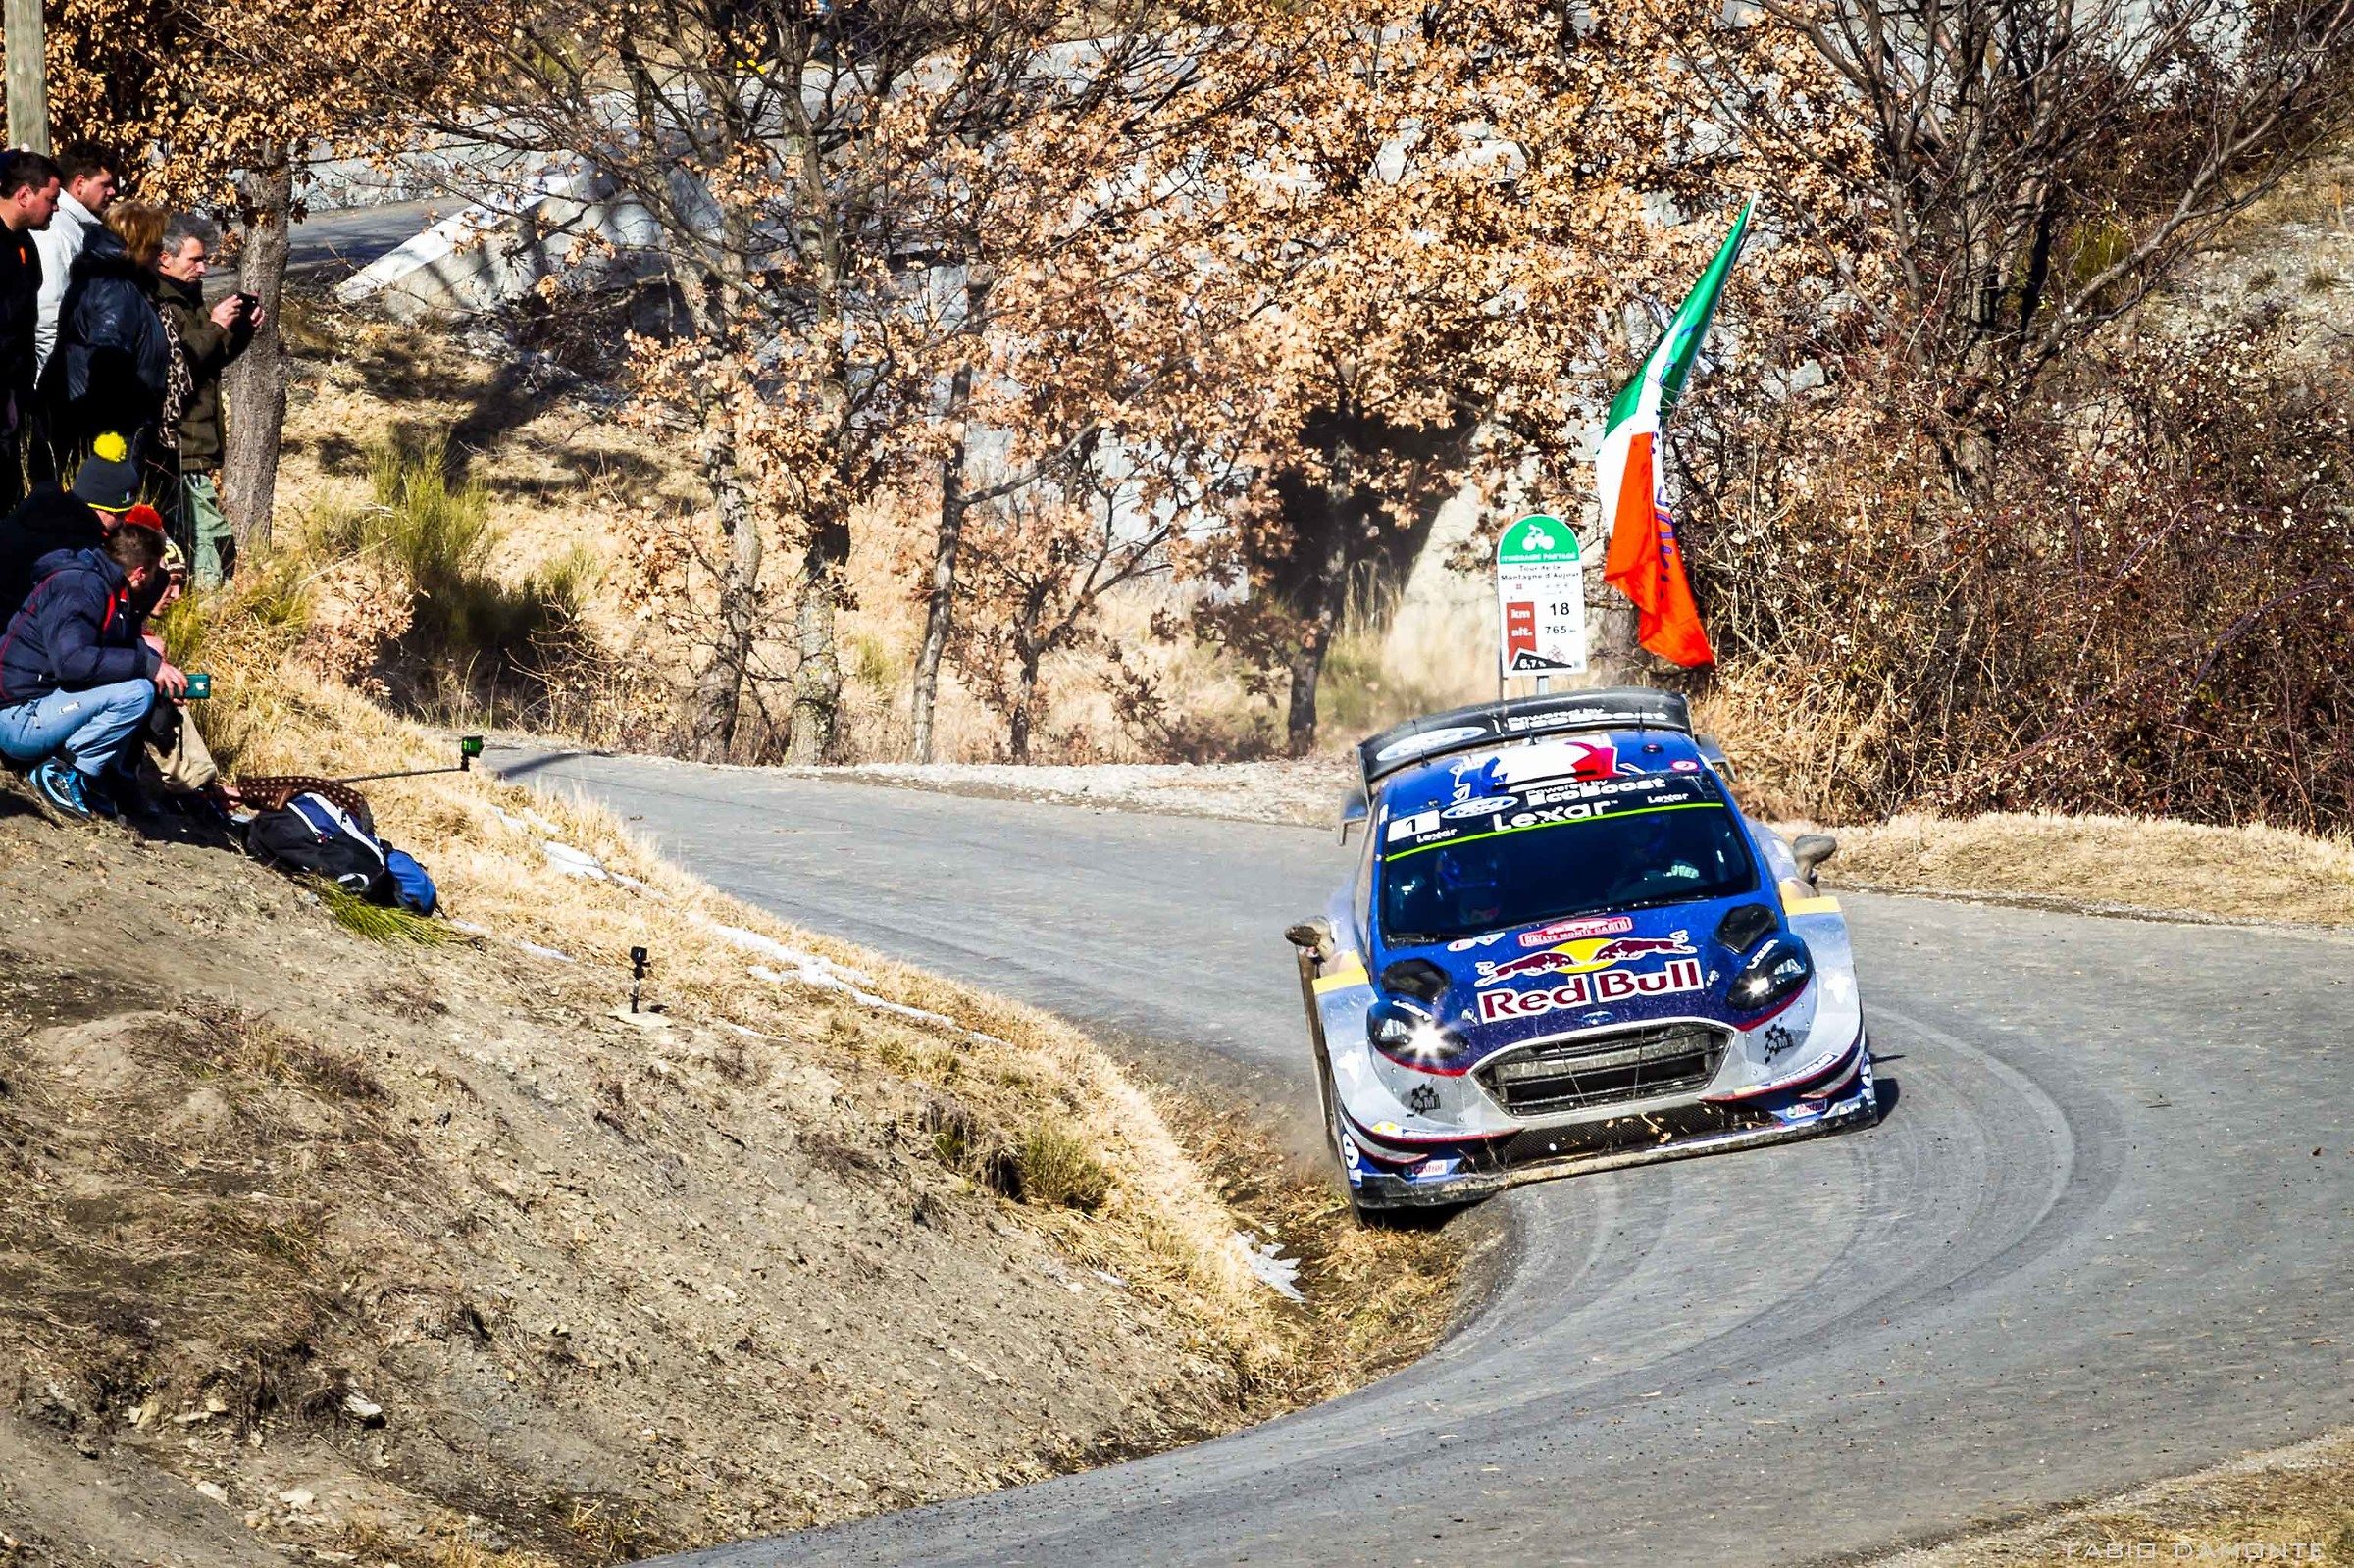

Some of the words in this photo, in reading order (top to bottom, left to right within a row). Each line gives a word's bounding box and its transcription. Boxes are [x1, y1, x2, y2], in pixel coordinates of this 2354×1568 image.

[1510, 609, 1530, 619] km
[1550, 602, 1569, 616] 18
[1545, 625, 1567, 634] 765
[1526, 777, 1666, 806] EcoBoost
[1406, 818, 1416, 833] 1
[1416, 828, 1458, 844] Lexar
[1492, 800, 1611, 833] Lexar
[1647, 792, 1689, 805] Lexar
[1482, 977, 1587, 1019] Red
[1597, 961, 1699, 999] Bull
